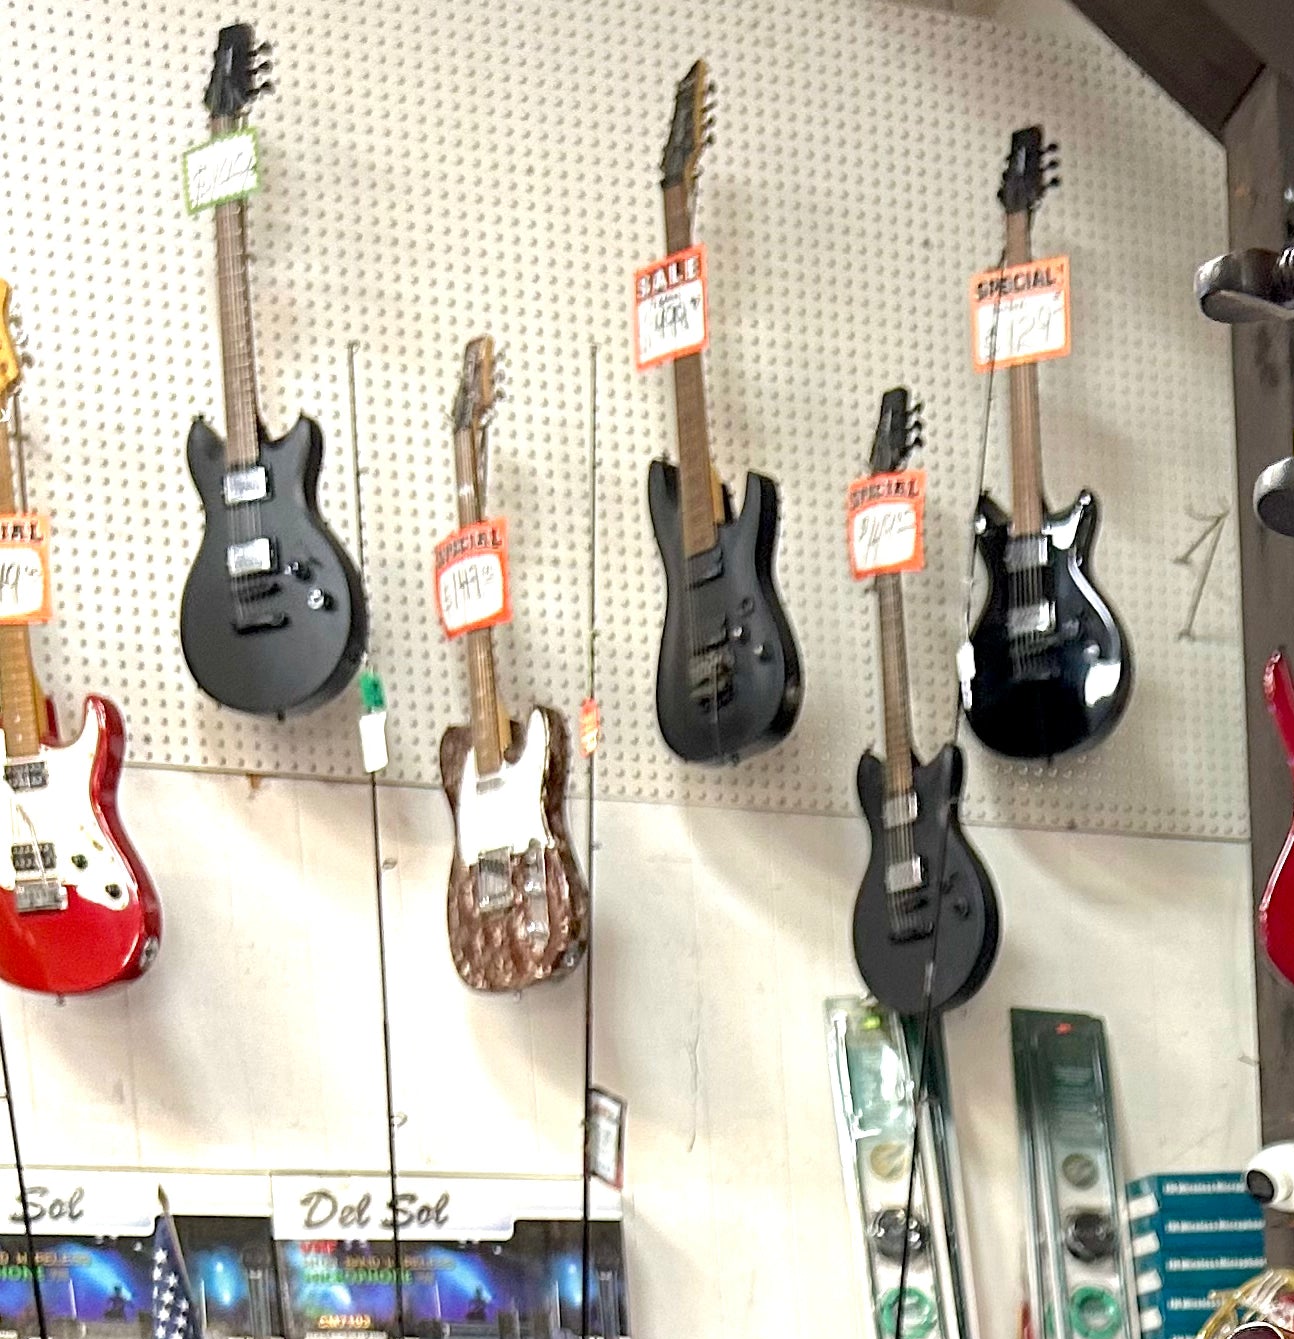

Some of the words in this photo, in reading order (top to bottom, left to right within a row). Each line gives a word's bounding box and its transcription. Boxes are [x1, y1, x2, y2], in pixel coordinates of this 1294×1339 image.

[638, 256, 701, 297] SALE
[977, 266, 1055, 300] SPECIAL
[9, 1186, 86, 1224] Sol
[300, 1189, 372, 1230] Del
[380, 1190, 450, 1230] Sol
